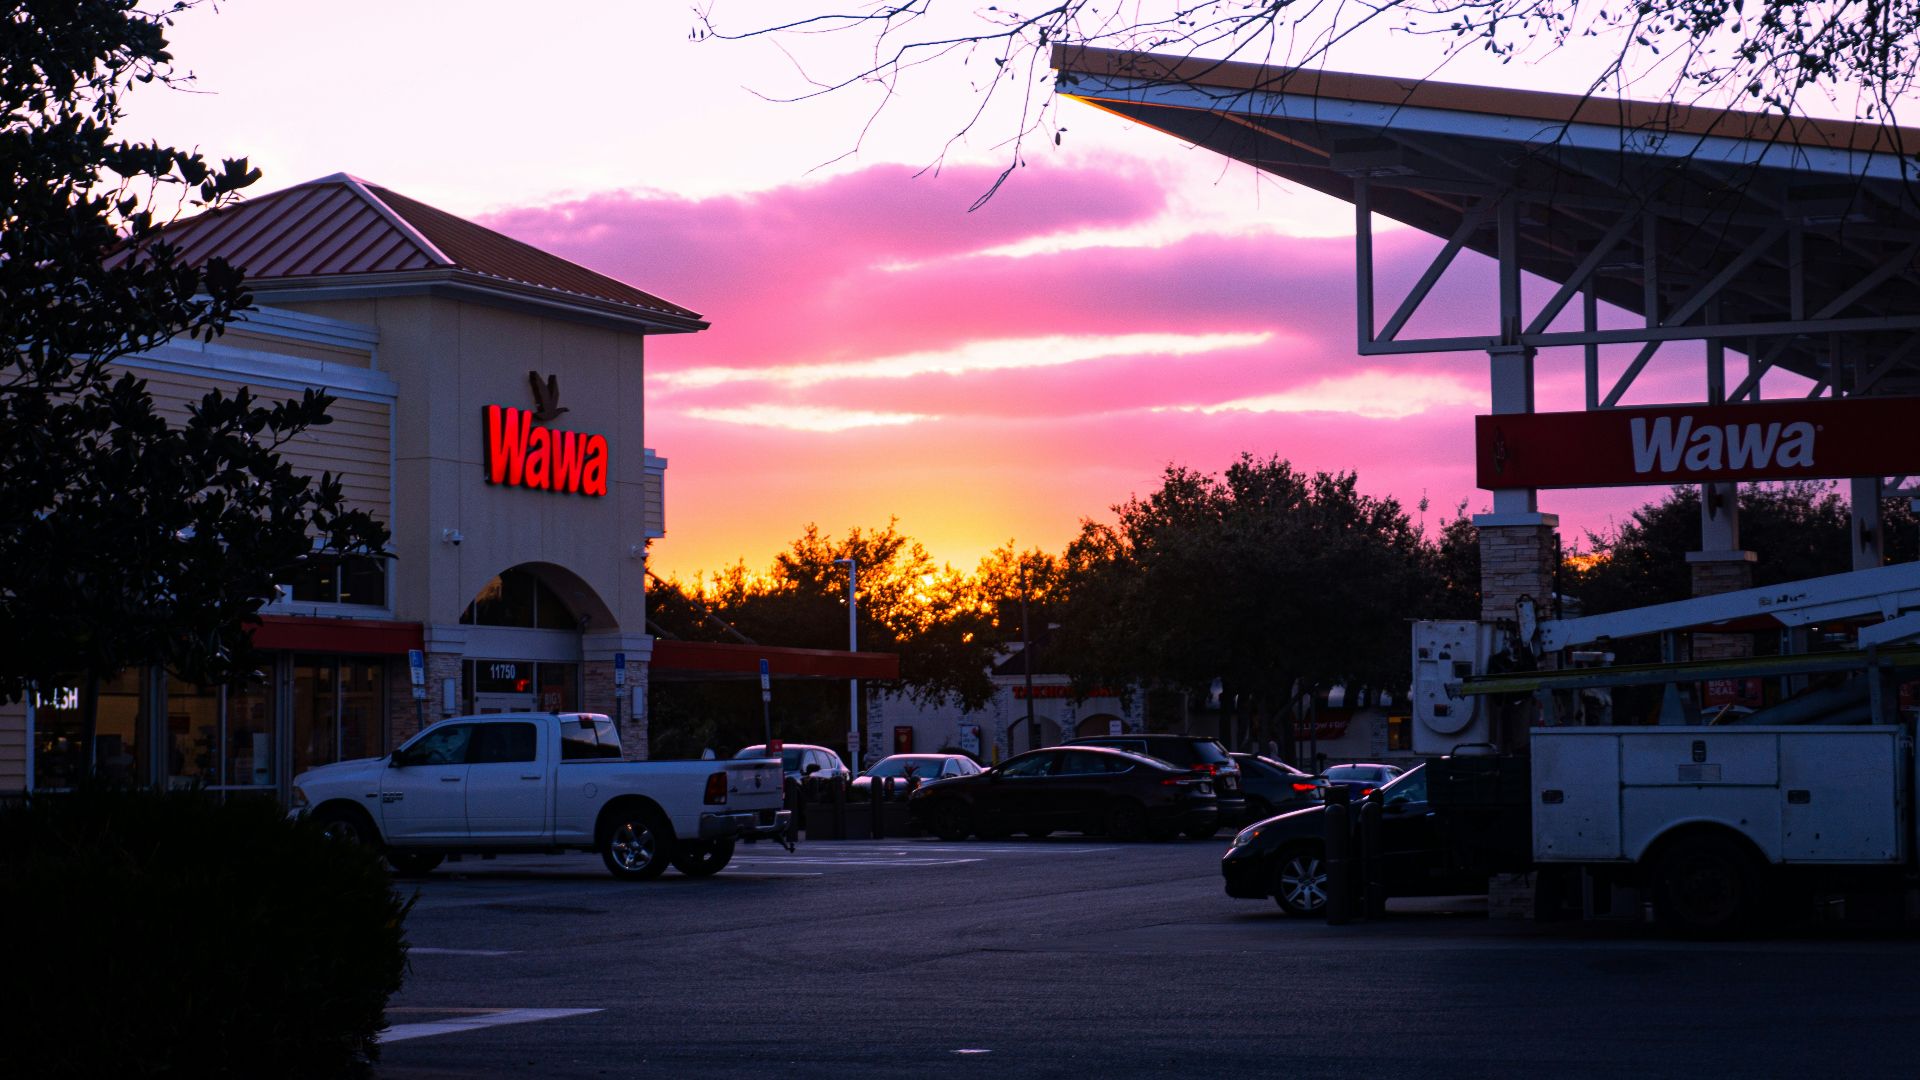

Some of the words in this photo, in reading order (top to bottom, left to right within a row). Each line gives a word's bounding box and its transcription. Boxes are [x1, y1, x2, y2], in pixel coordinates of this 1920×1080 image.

[489, 404, 608, 497] Wawa
[1630, 415, 1816, 473] Wawa
[490, 664, 516, 680] 11750
[1709, 687, 1735, 696] DEAL
[1294, 721, 1326, 730] TLLOW
